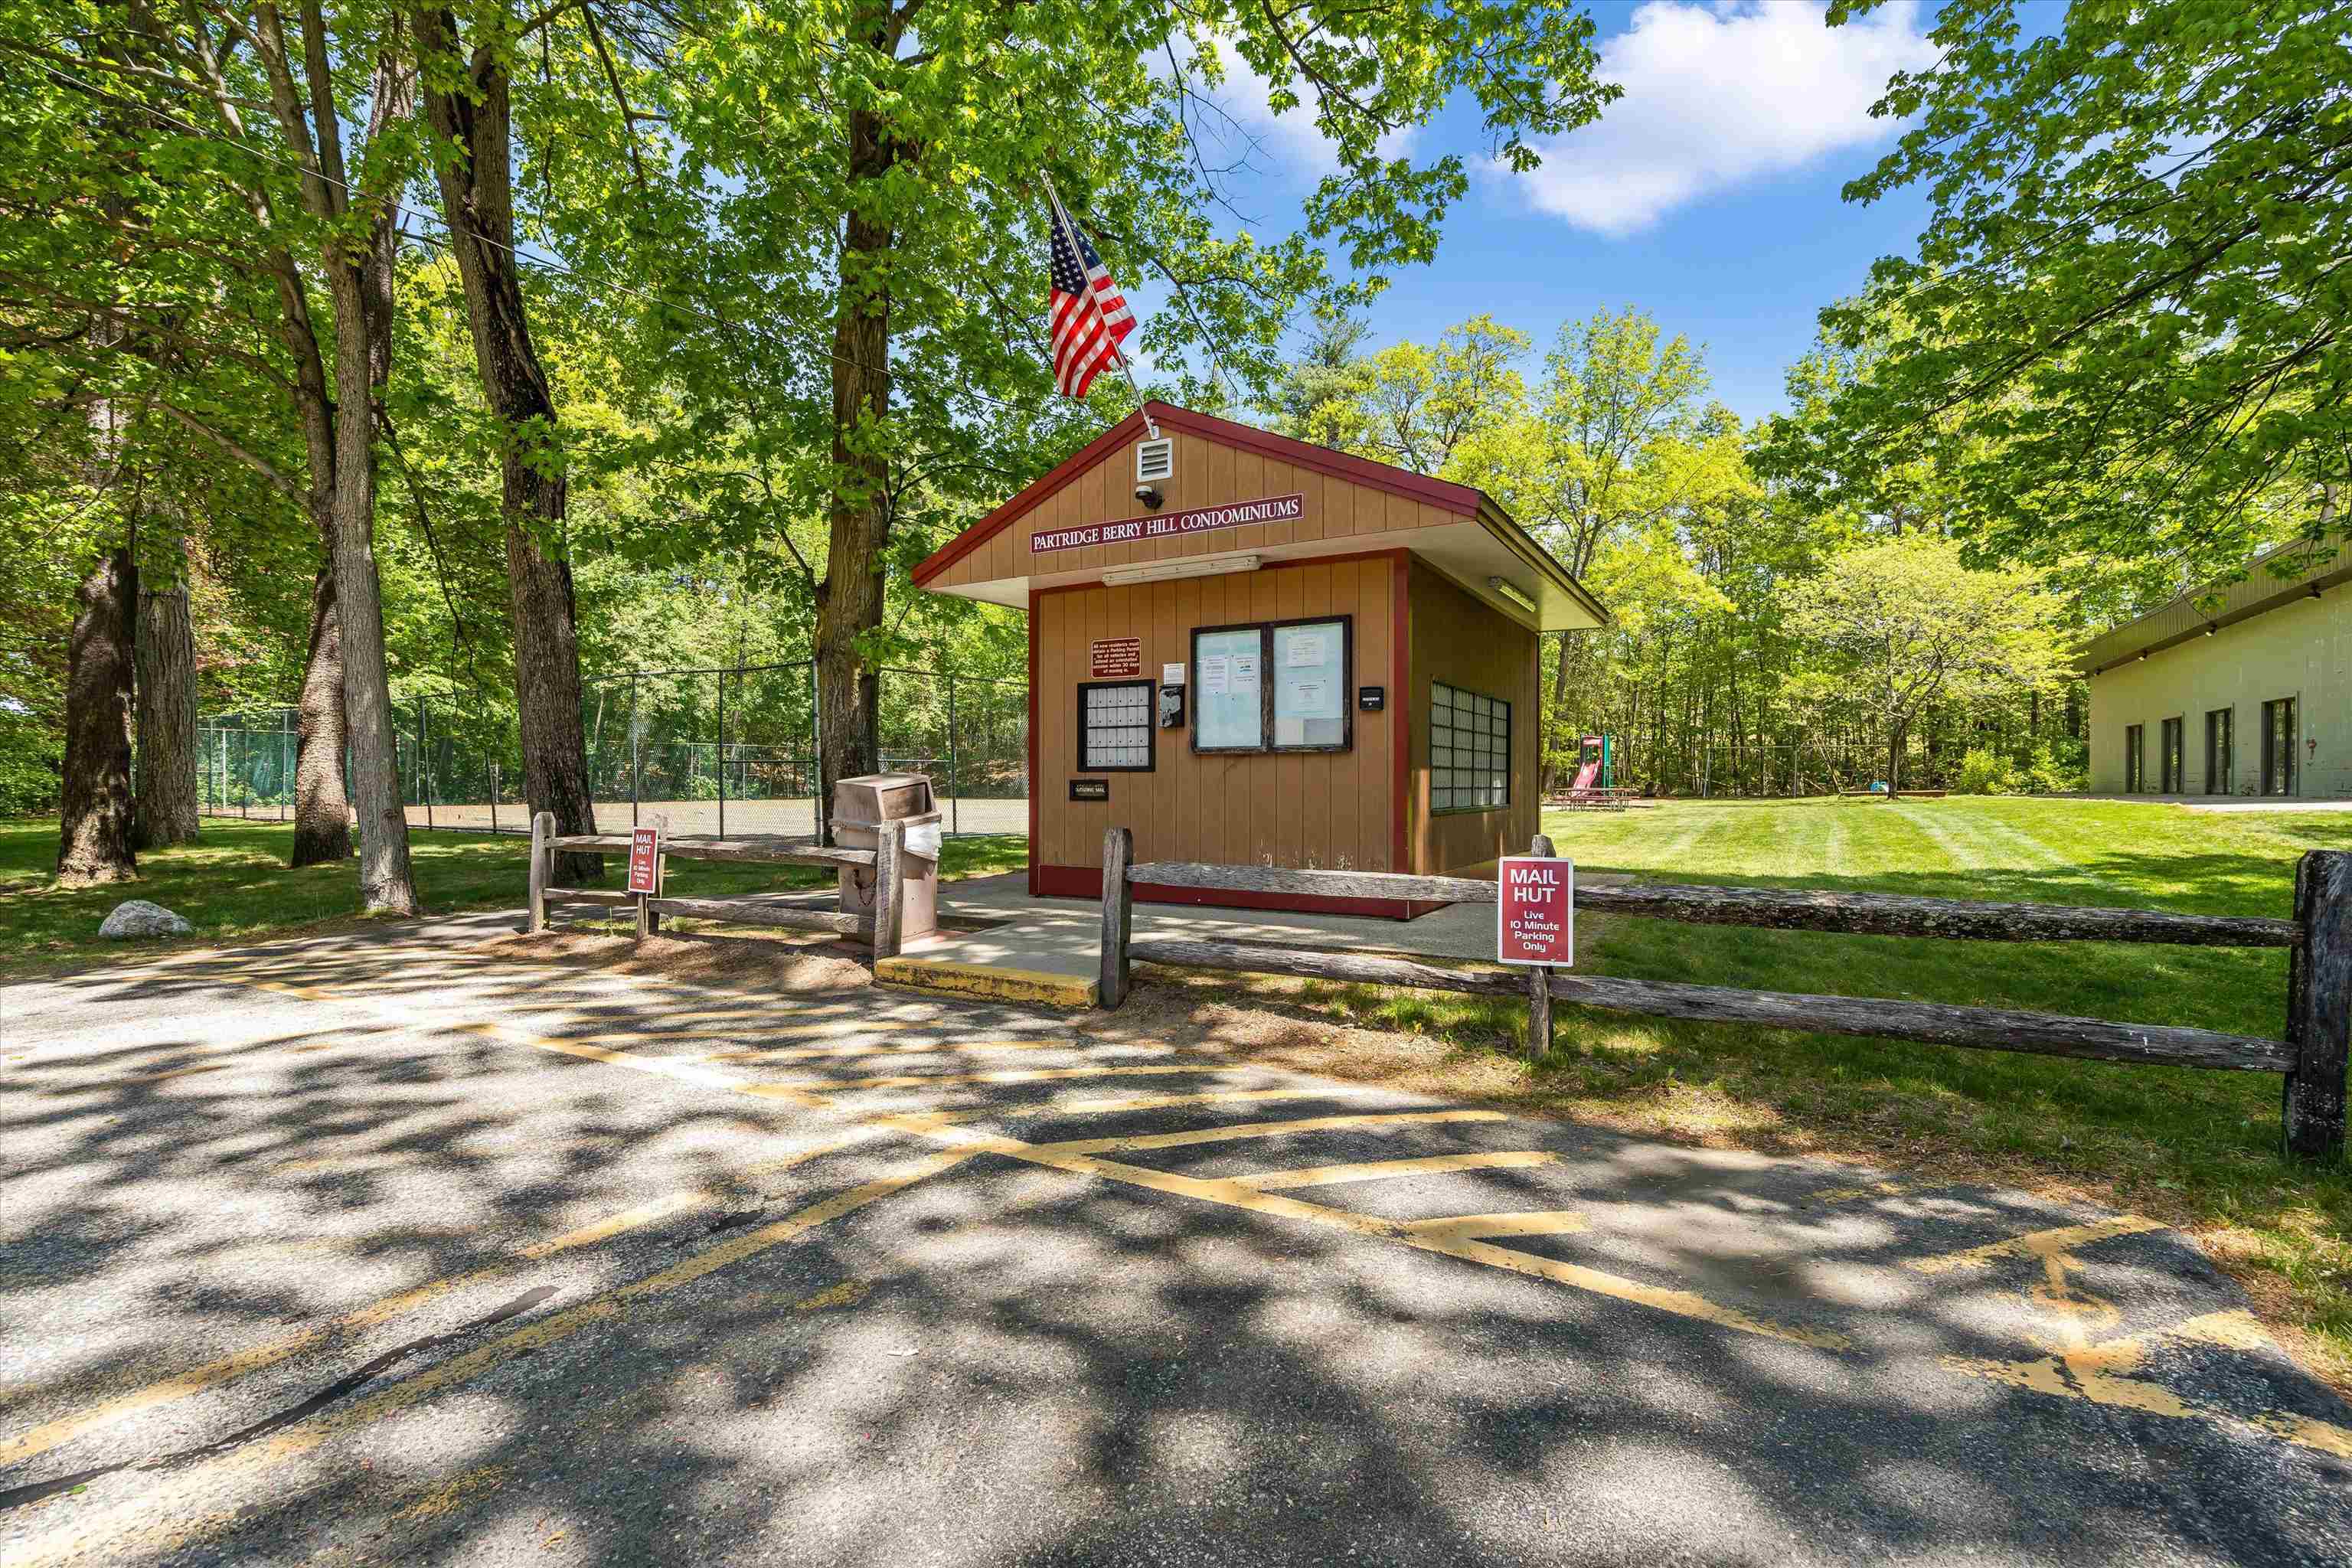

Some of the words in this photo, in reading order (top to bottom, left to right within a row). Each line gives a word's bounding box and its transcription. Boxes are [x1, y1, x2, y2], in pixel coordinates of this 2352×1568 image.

[1034, 528, 1099, 550] PARTRIDGE
[1102, 521, 1144, 541] BERRY
[1146, 517, 1178, 534] HILL
[1181, 499, 1298, 529] CONDOMINIUMS
[636, 834, 653, 844] MAIL
[636, 845, 651, 856] HUT
[1510, 869, 1560, 884] MAIL
[1514, 887, 1556, 903] HUT
[1524, 910, 1544, 920] Live
[1510, 920, 1521, 929] 10
[1524, 921, 1560, 931] Minute
[1514, 931, 1555, 942] Parking
[1523, 942, 1547, 952] Only
